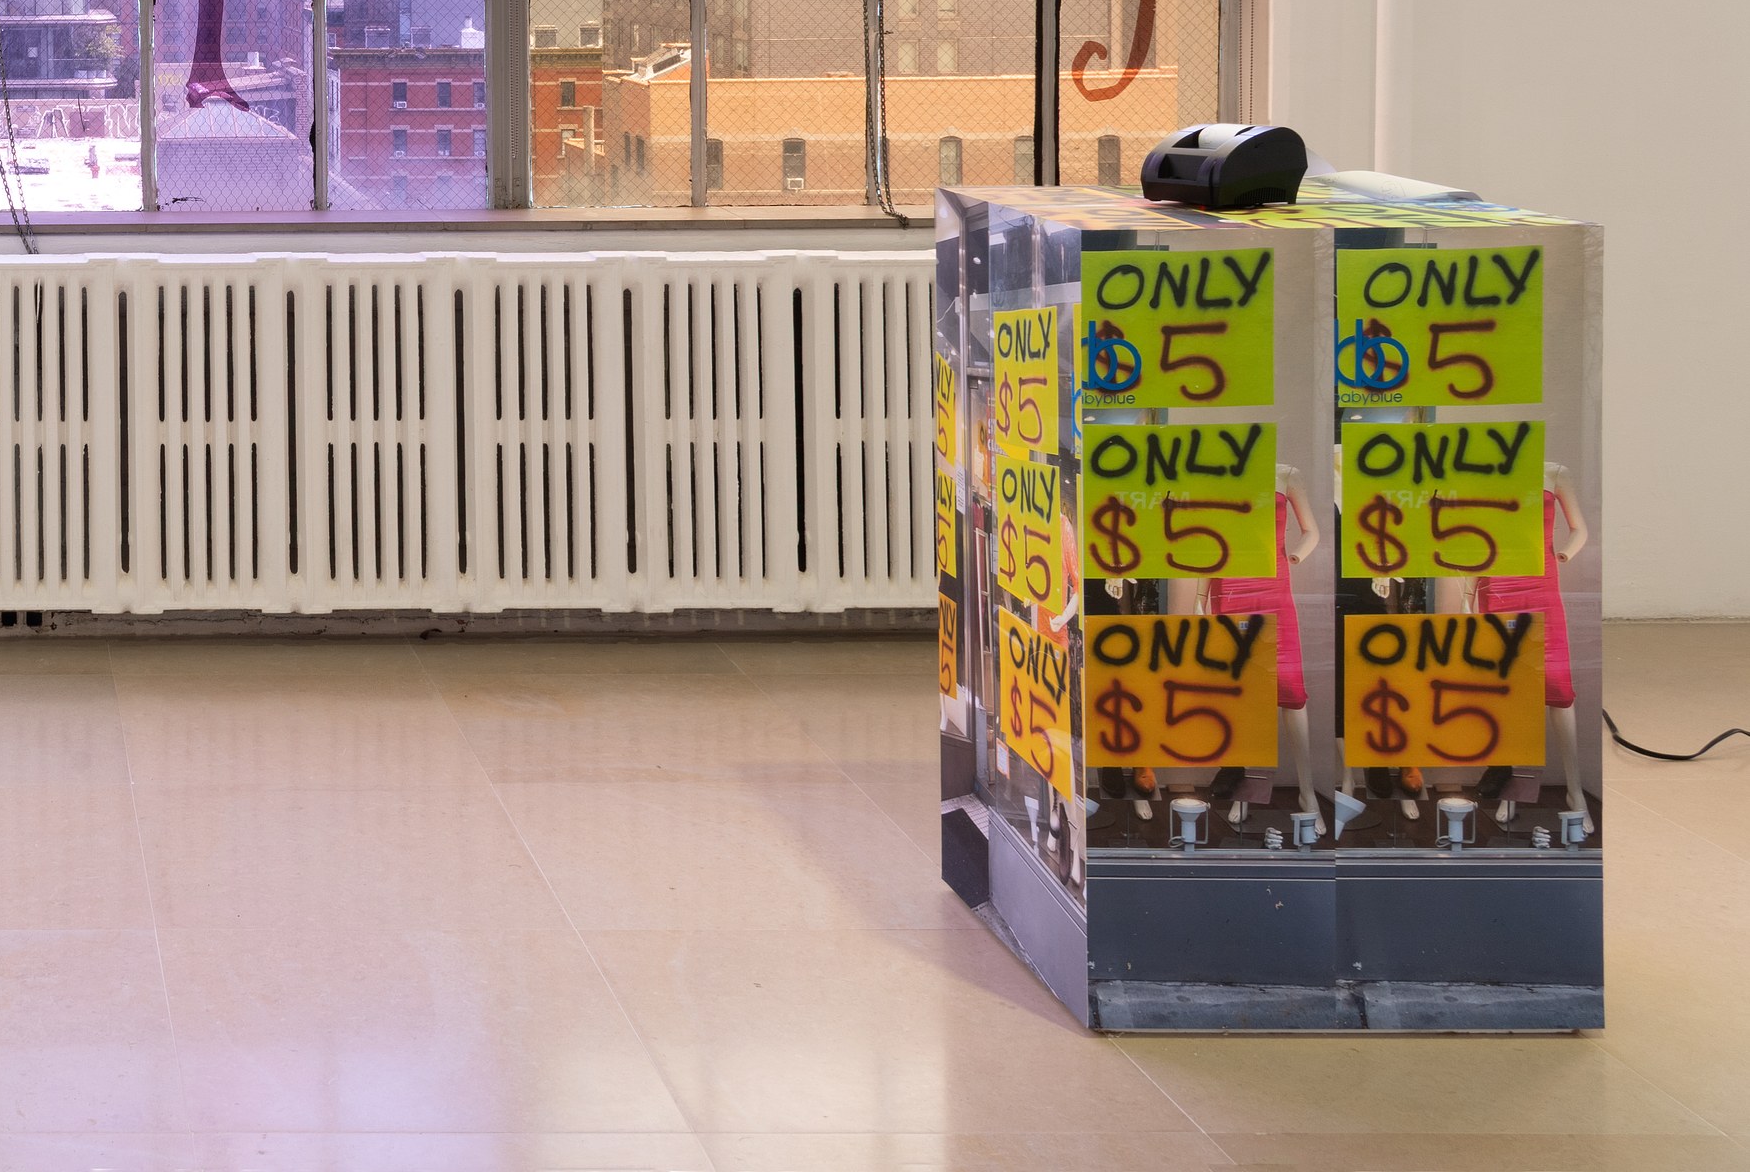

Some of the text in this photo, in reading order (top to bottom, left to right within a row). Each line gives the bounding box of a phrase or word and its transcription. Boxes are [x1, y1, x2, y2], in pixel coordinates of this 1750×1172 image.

[1097, 251, 1270, 310] ONLY
[1364, 249, 1540, 309] ONLY
[998, 311, 1052, 363] ONLY
[997, 371, 1047, 445] $5
[1091, 424, 1262, 486] ONLY
[1357, 422, 1530, 484] ONLY
[1002, 466, 1056, 524] ONLY
[1000, 514, 1051, 602] $5
[1089, 492, 1251, 574] $5
[1356, 490, 1519, 573] $5
[1008, 625, 1066, 706] ONLY
[1093, 614, 1264, 680] ONLY
[1360, 613, 1532, 678] ONLY
[1010, 676, 1057, 779] $5
[1095, 679, 1242, 762] $5
[1361, 678, 1510, 762] $5
